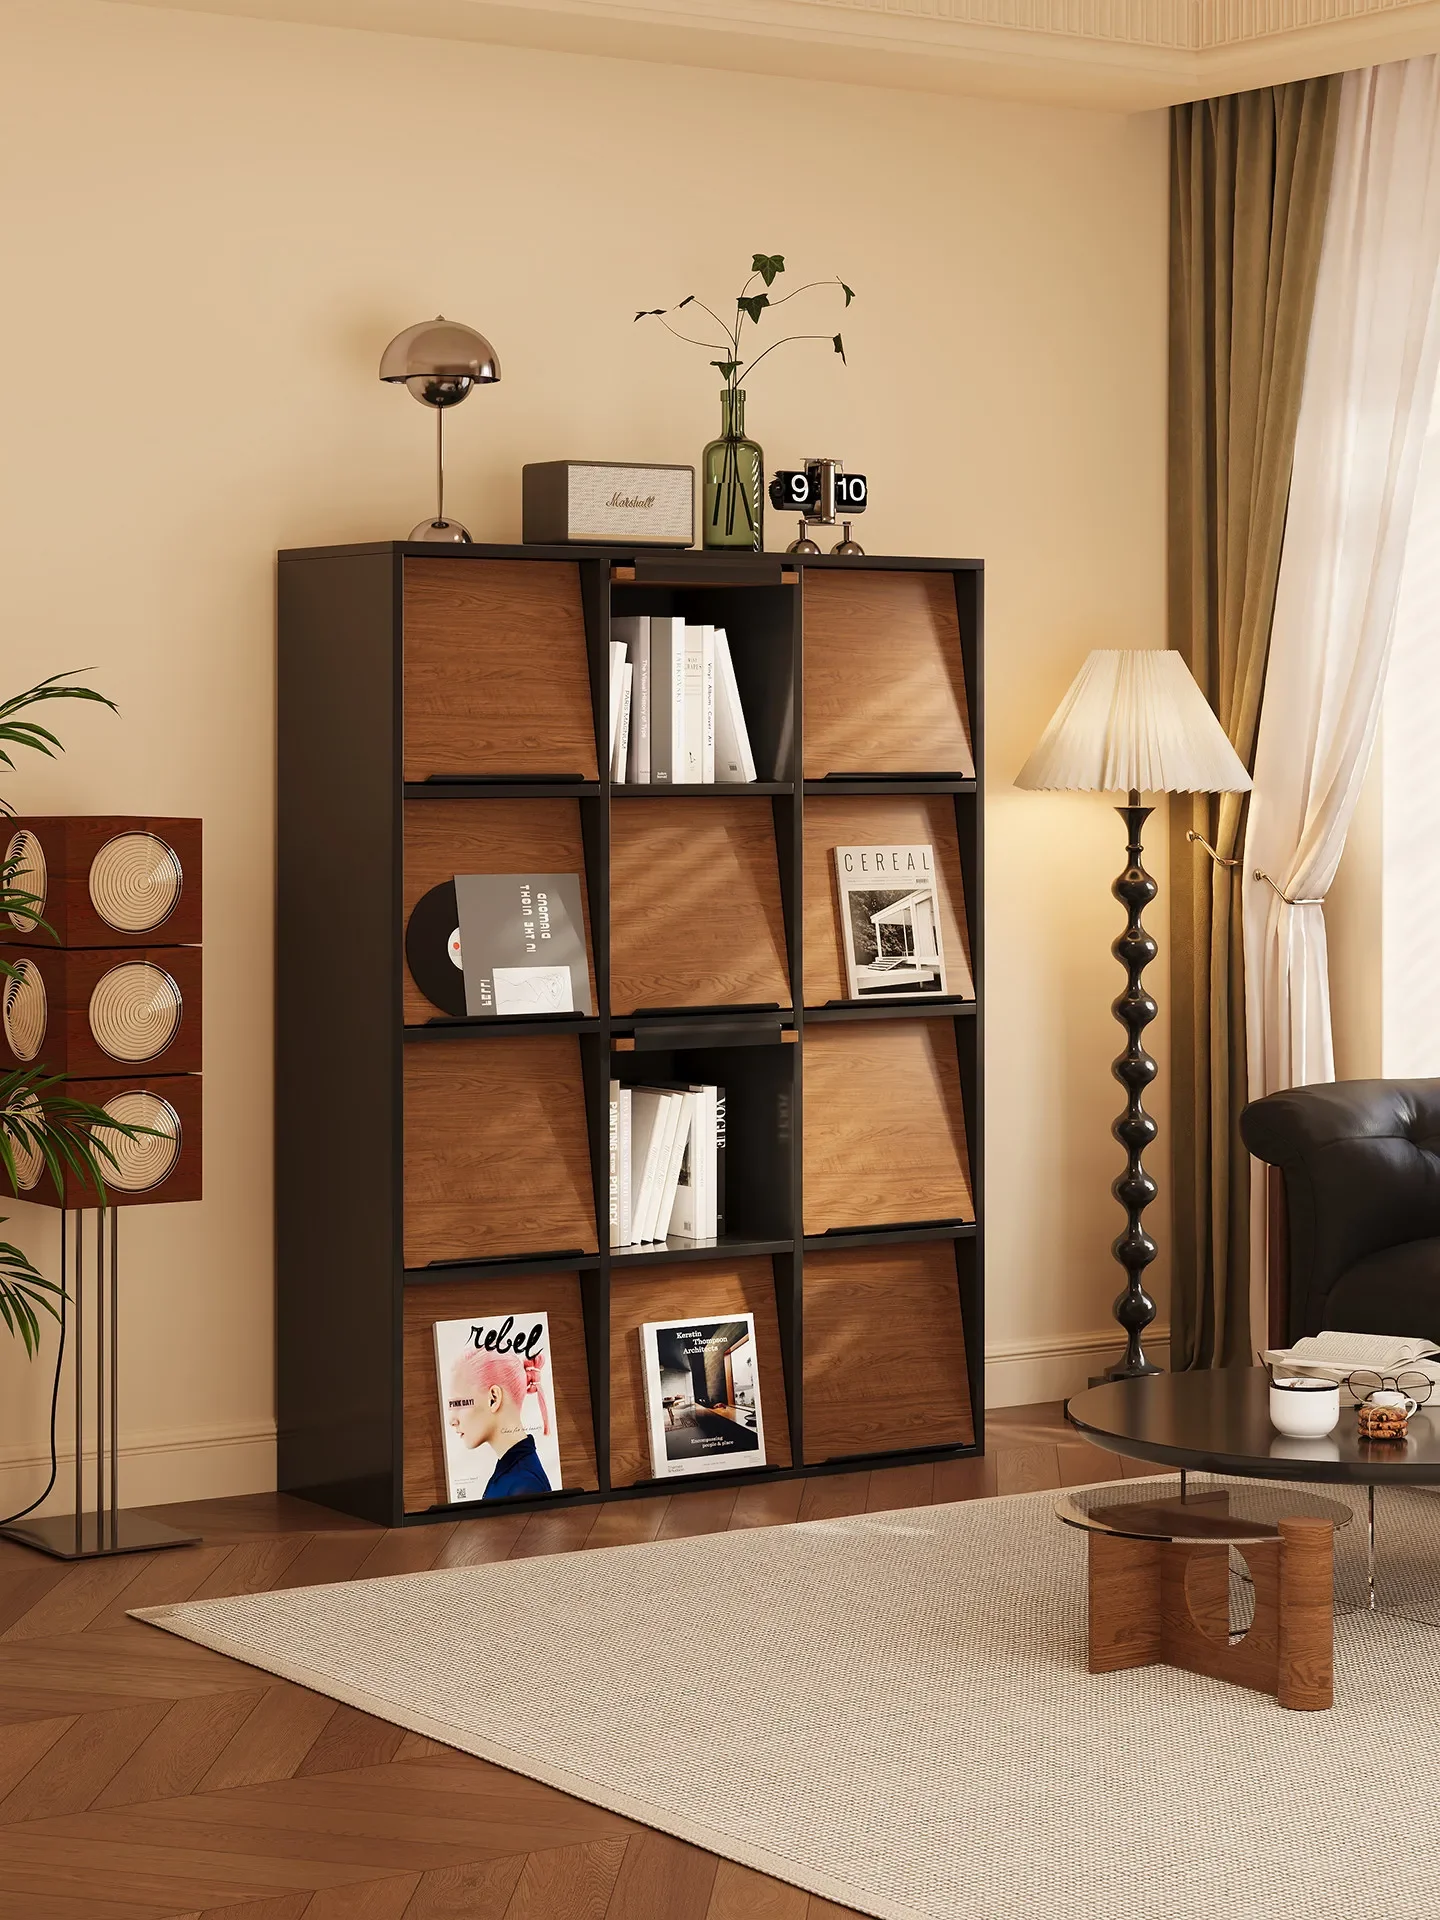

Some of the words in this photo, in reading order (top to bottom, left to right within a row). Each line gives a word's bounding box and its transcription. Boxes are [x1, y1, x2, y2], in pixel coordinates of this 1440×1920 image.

[791, 474, 809, 502] 9
[837, 477, 866, 501] 10
[605, 491, 655, 509] Marshall
[844, 852, 930, 872] CEREAL
[716, 1096, 726, 1149] VOGUE
[464, 1316, 544, 1360] rebel
[676, 1331, 702, 1339] Kerstin
[693, 1337, 728, 1345] Thompson
[683, 1345, 719, 1354] Architects
